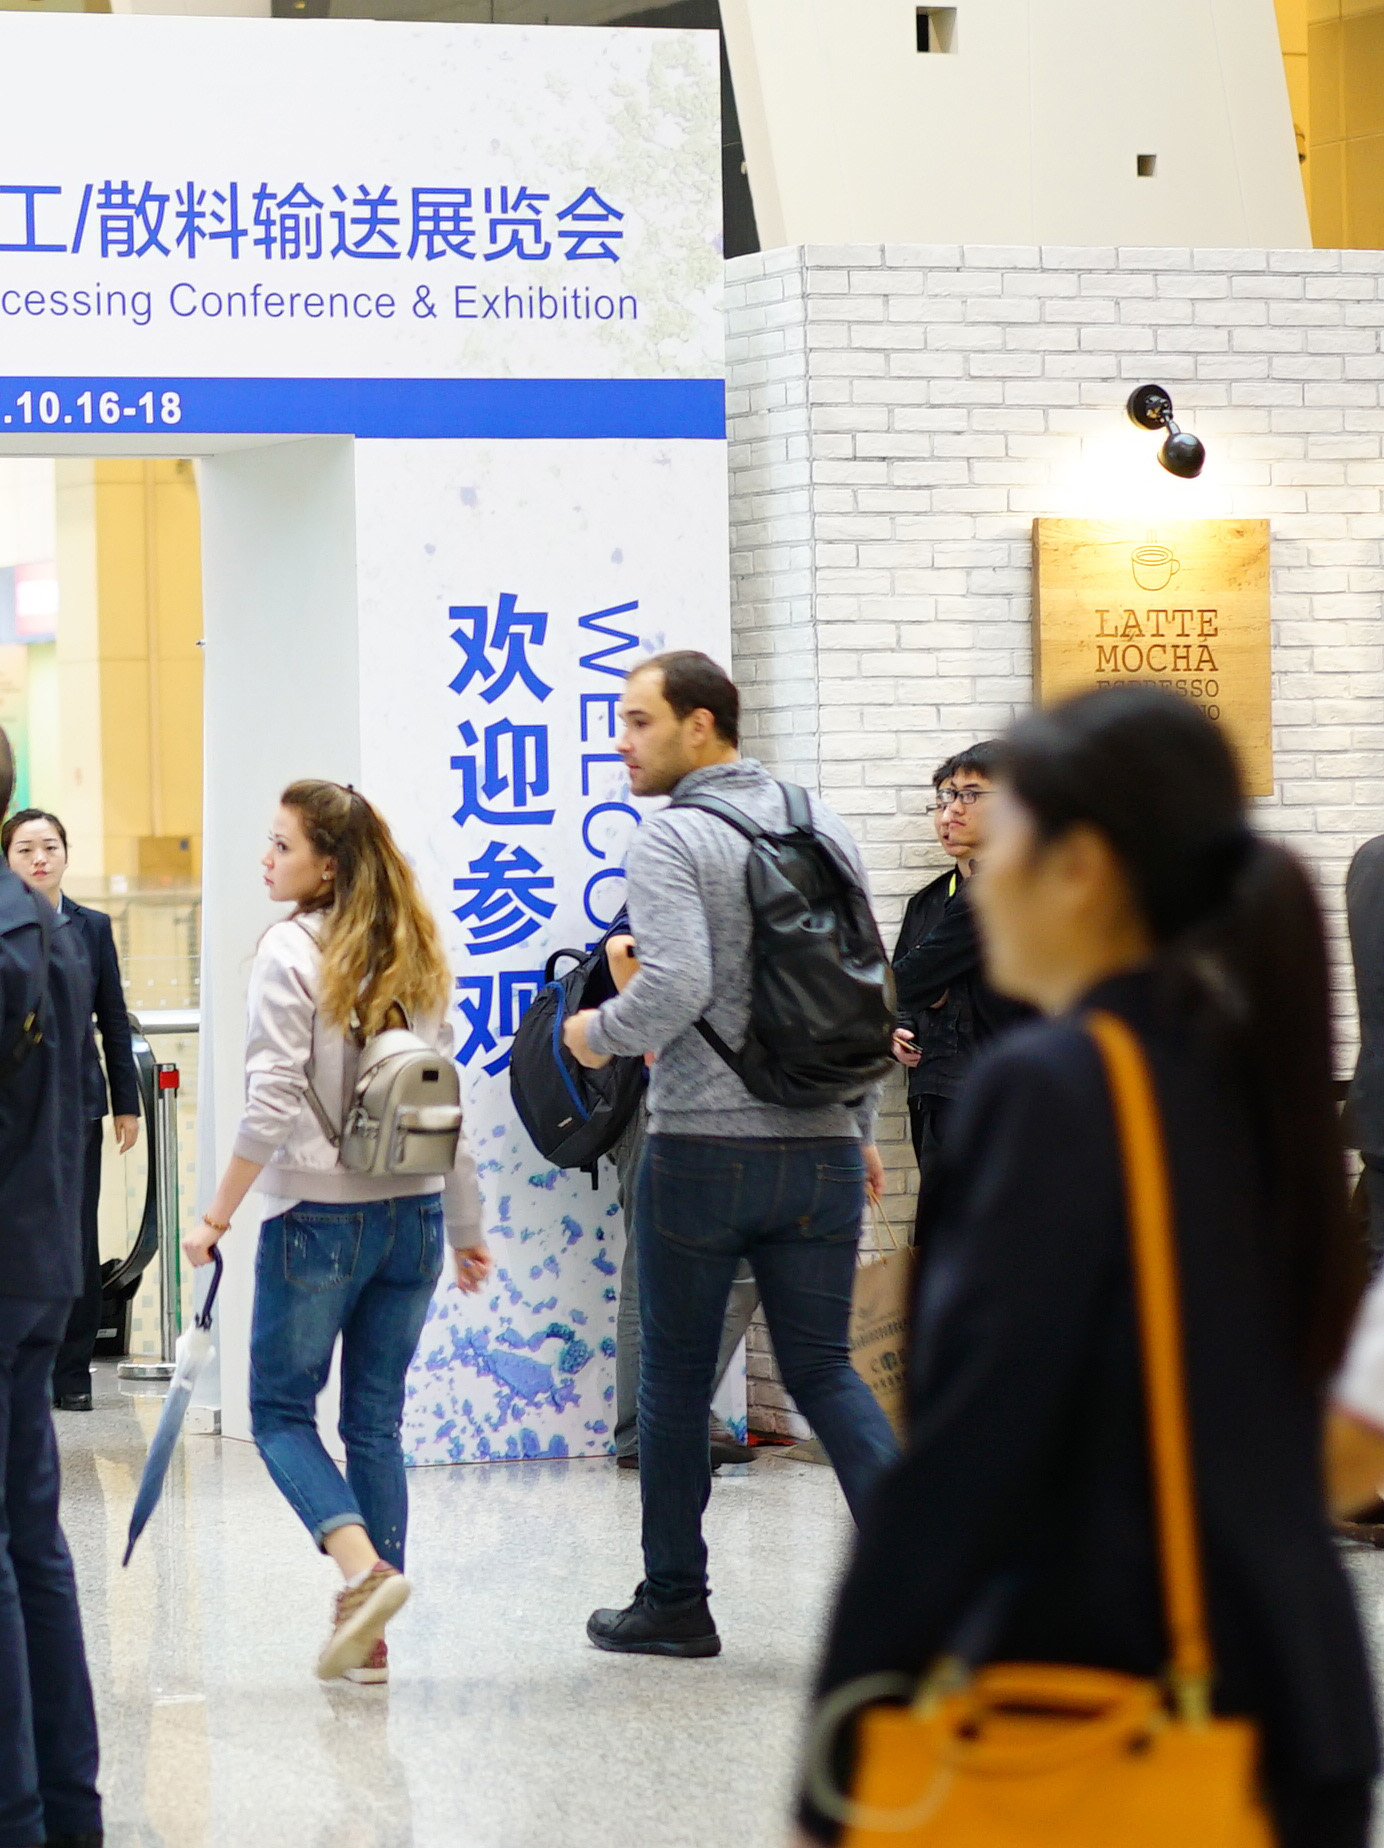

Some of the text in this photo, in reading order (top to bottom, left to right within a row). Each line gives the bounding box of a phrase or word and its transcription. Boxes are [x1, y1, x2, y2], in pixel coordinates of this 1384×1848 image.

[169, 282, 396, 319] Conference
[411, 284, 438, 319] &
[454, 285, 638, 321] Exhibition
[1095, 609, 1218, 638] LATTE
[1095, 644, 1219, 672] MOCHA
[578, 599, 643, 952] WELCO
